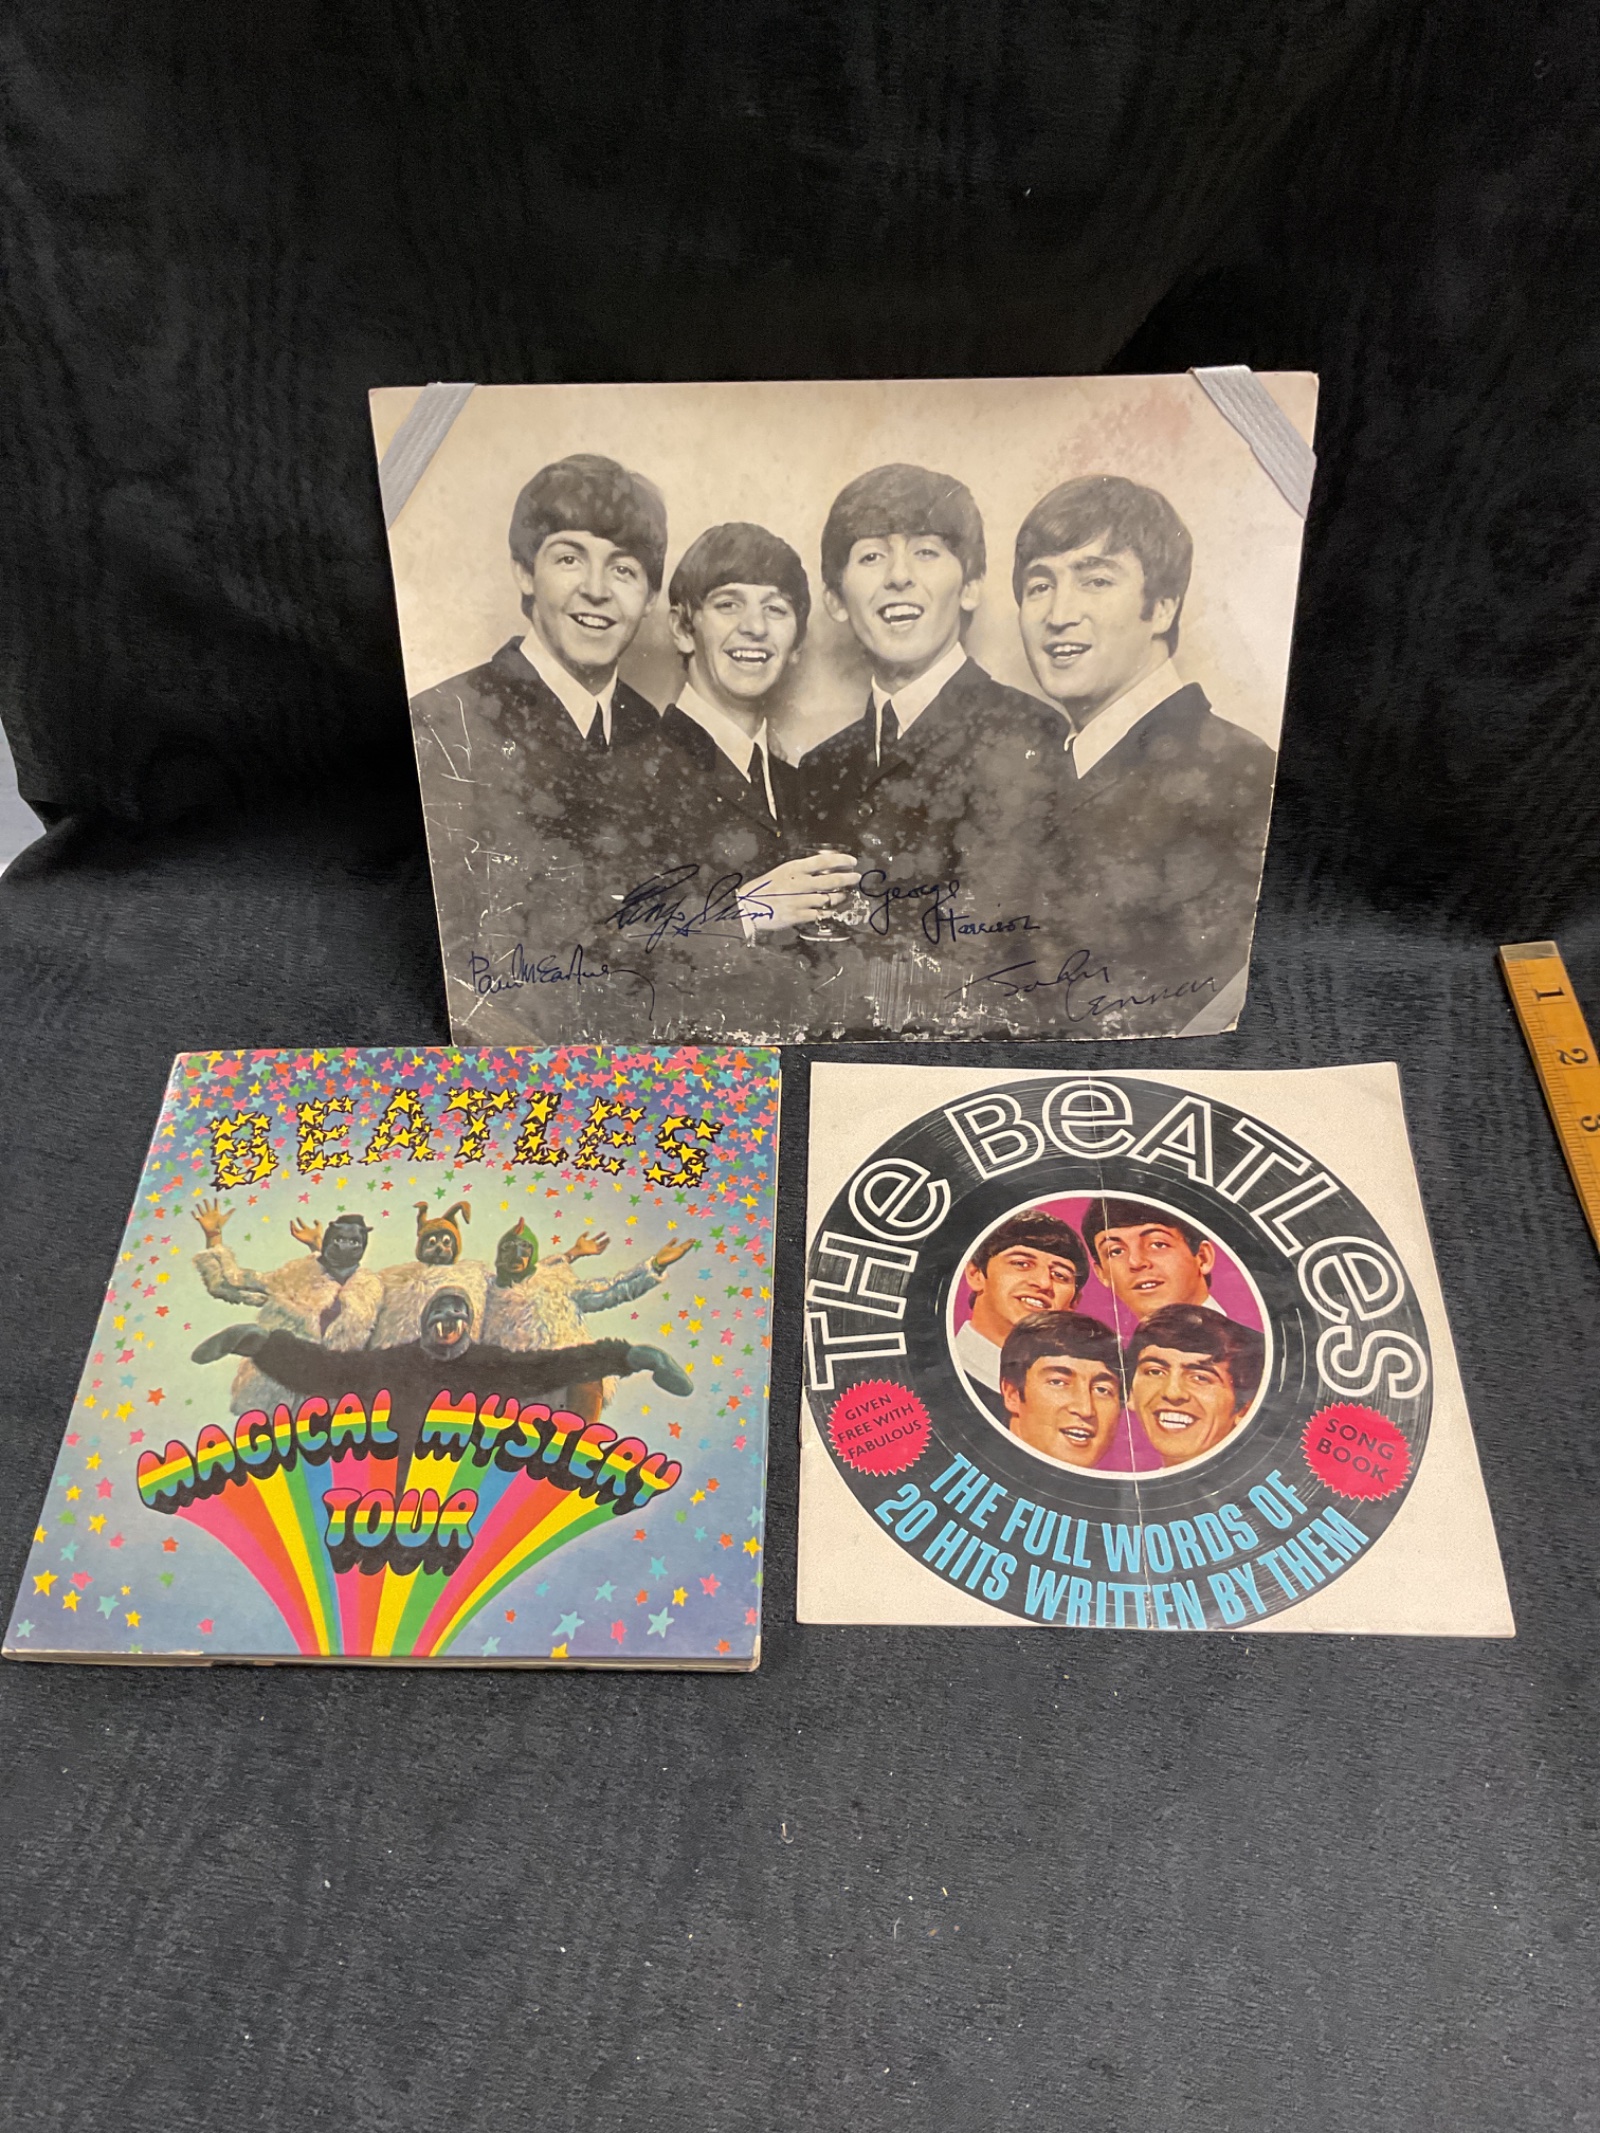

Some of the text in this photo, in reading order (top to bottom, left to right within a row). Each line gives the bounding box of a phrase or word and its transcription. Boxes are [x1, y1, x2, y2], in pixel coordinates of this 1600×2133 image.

[859, 869, 960, 944] George
[1556, 1047, 1589, 1066] 2
[209, 1087, 724, 1190] BEATLES
[837, 1403, 914, 1443] FREE WITH
[845, 1394, 892, 1420] GIVEN
[137, 1389, 683, 1515] MAGICAL MYSTERY
[848, 1420, 922, 1459] FABULOUS
[1316, 1437, 1389, 1483] BOOK
[1325, 1418, 1395, 1461] SONG
[323, 1488, 479, 1565] TOUR
[930, 1452, 1308, 1573] THE FULL WORDS OF
[874, 1483, 1370, 1631] 20 HITS WRITTEN BY THEM
